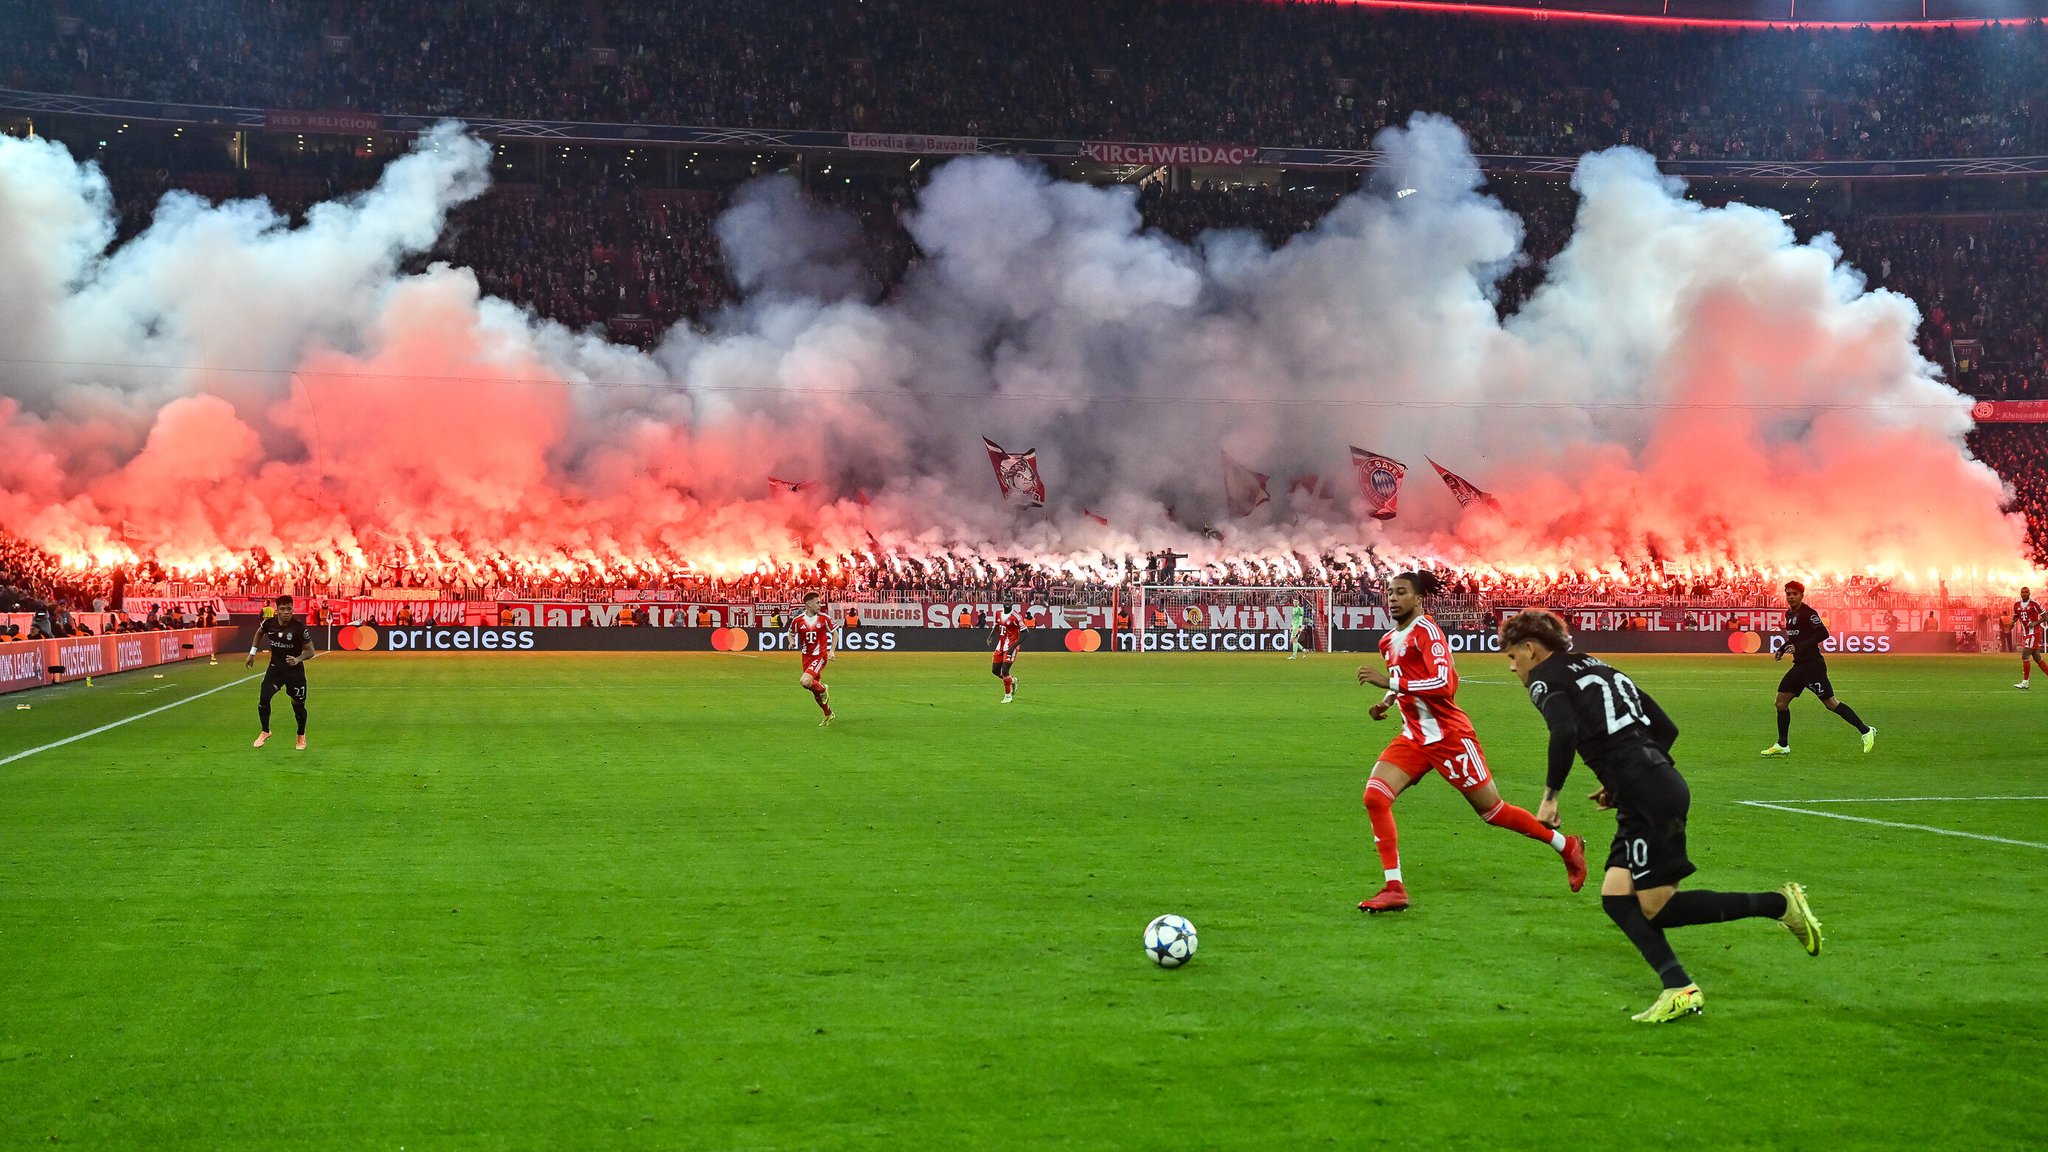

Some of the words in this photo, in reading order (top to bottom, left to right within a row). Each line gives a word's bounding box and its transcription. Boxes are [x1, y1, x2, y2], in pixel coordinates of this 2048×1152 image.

[272, 115, 300, 125] RED
[308, 116, 377, 129] RELIGION
[850, 135, 903, 148] Erfordia
[926, 138, 975, 150] Bavaria
[432, 602, 467, 624] PRIDE
[389, 626, 535, 651] priceless
[805, 631, 817, 644] T
[1117, 629, 1289, 650] mastercard
[14, 651, 36, 680] LEAGUE
[60, 643, 103, 677] mastercard
[1575, 672, 1651, 735] 20
[1443, 752, 1469, 779] 17
